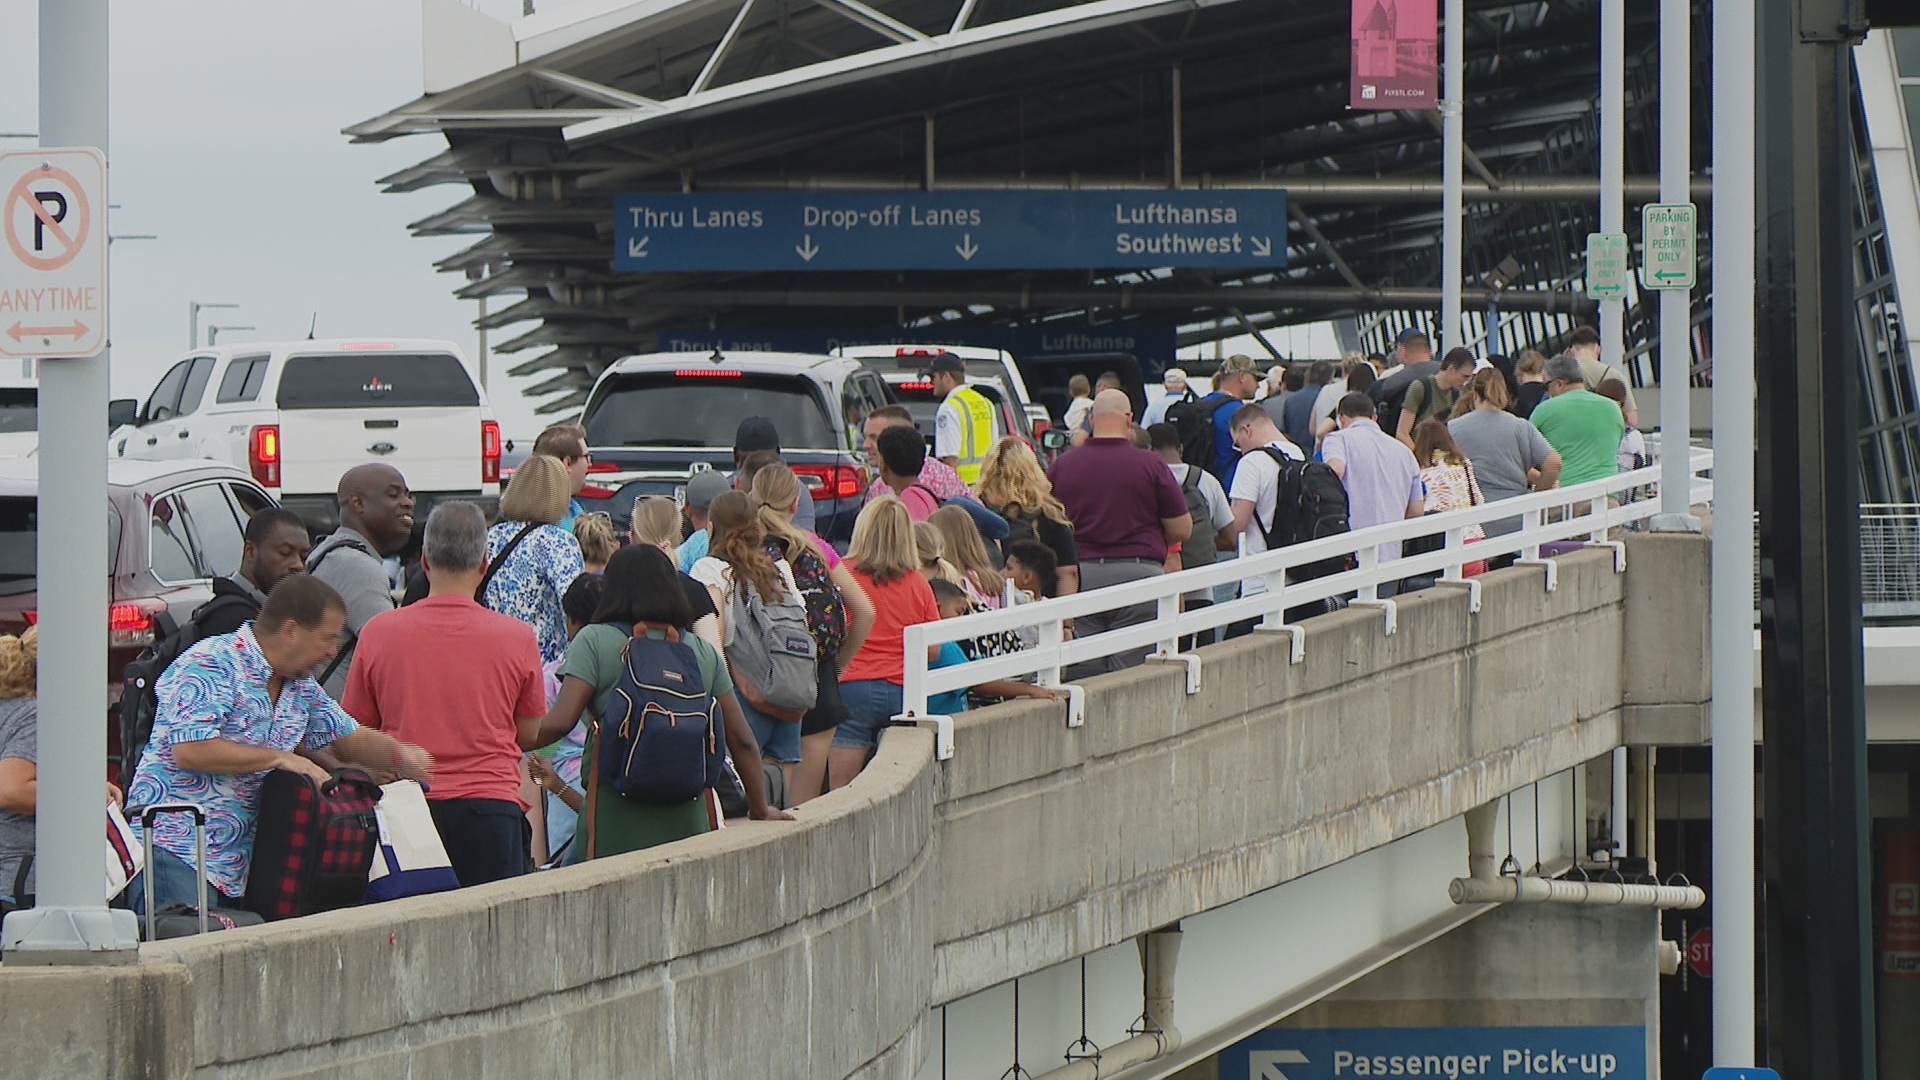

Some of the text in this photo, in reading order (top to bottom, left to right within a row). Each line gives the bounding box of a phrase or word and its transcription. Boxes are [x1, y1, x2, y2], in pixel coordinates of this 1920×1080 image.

[1384, 88, 1425, 96] FLYSTL.COM
[629, 206, 764, 228] Thru Lanes
[803, 204, 982, 231] Drop-off Lanes
[1116, 203, 1238, 224] Lufthansa
[1649, 212, 1690, 223] PARKING
[1663, 226, 1675, 236] BY
[1116, 232, 1242, 254] Southwest
[1652, 238, 1687, 249] PERMIT
[1657, 252, 1681, 262] ONLY
[0, 287, 97, 314] ANYTIME
[1042, 333, 1136, 350] Lufthansa
[1333, 1048, 1617, 1080] Passenger Pick-up
